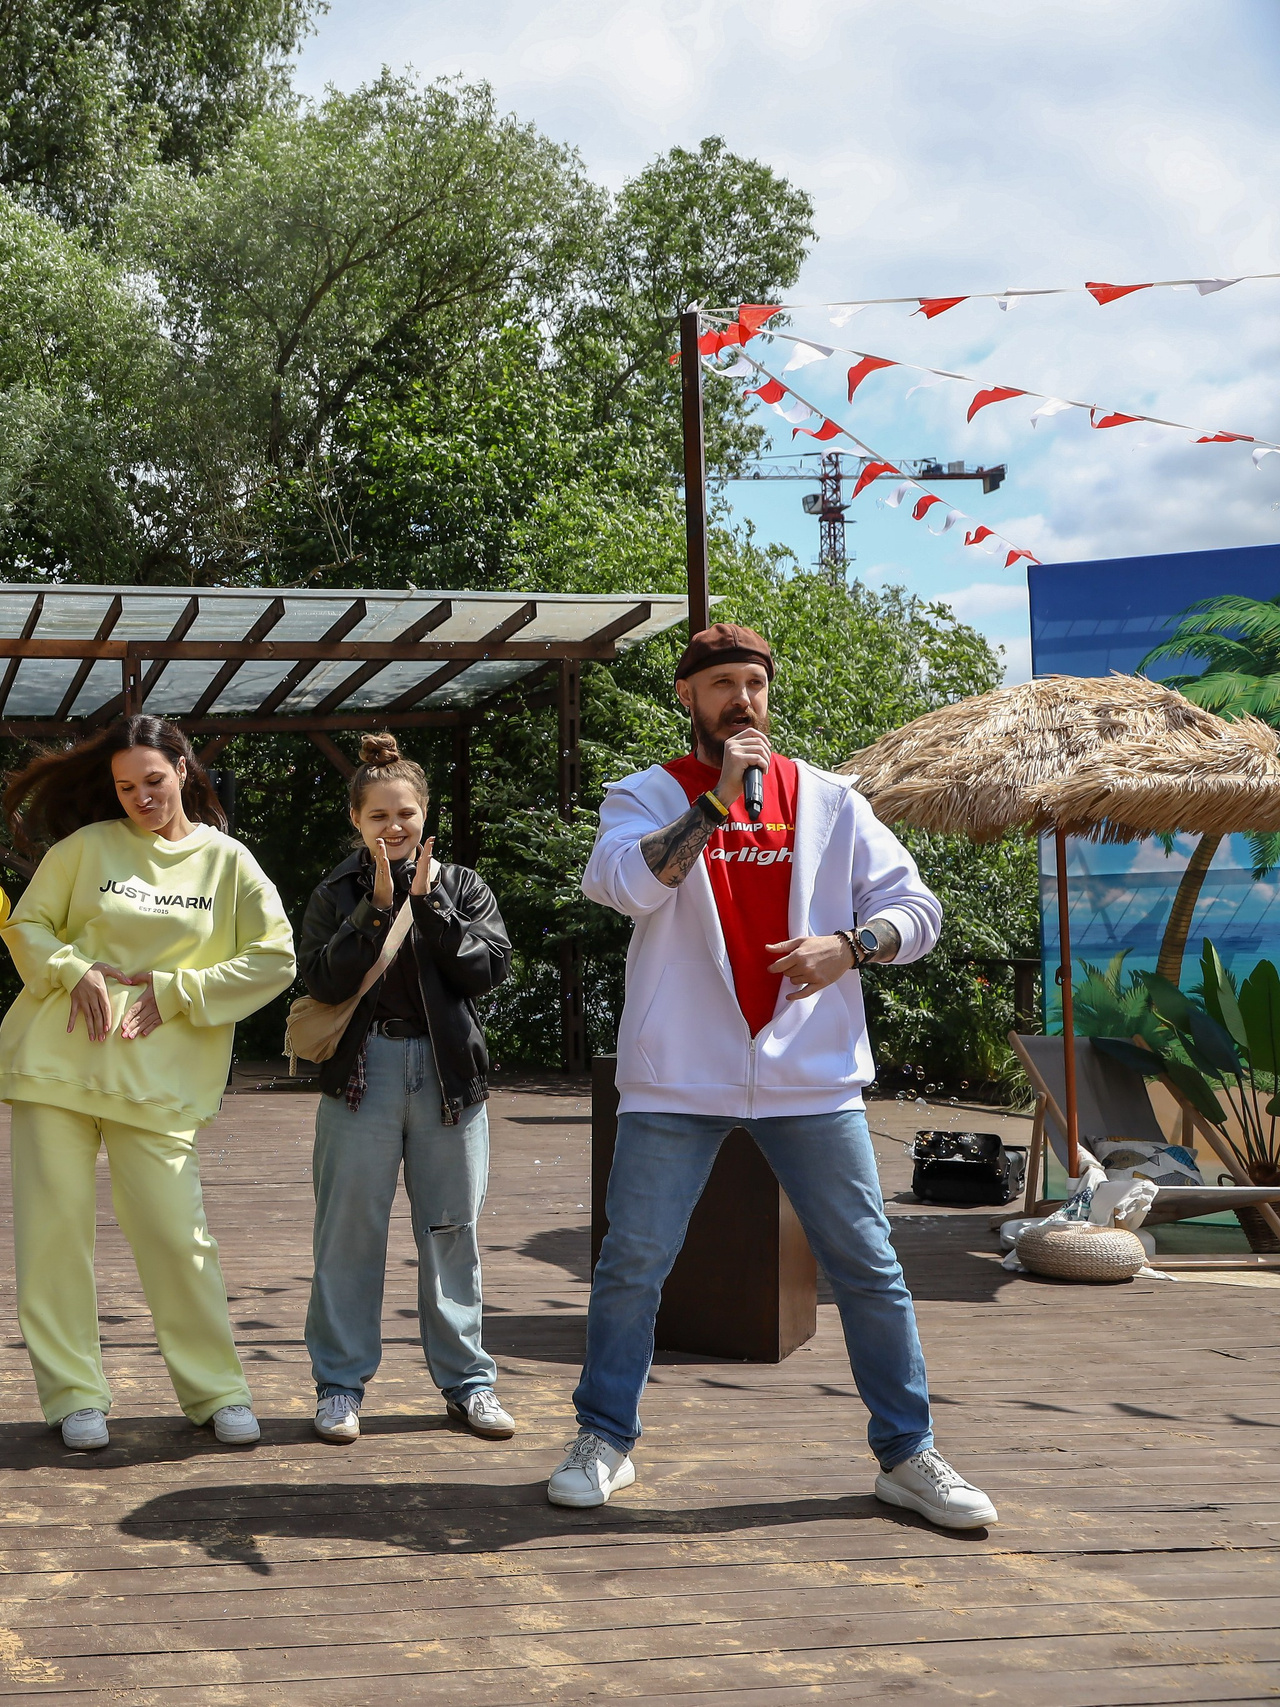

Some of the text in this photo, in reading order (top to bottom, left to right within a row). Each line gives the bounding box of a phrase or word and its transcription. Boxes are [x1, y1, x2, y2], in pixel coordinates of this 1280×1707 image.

[730, 821, 763, 832] МИР
[99, 880, 213, 912] JUST WARM
